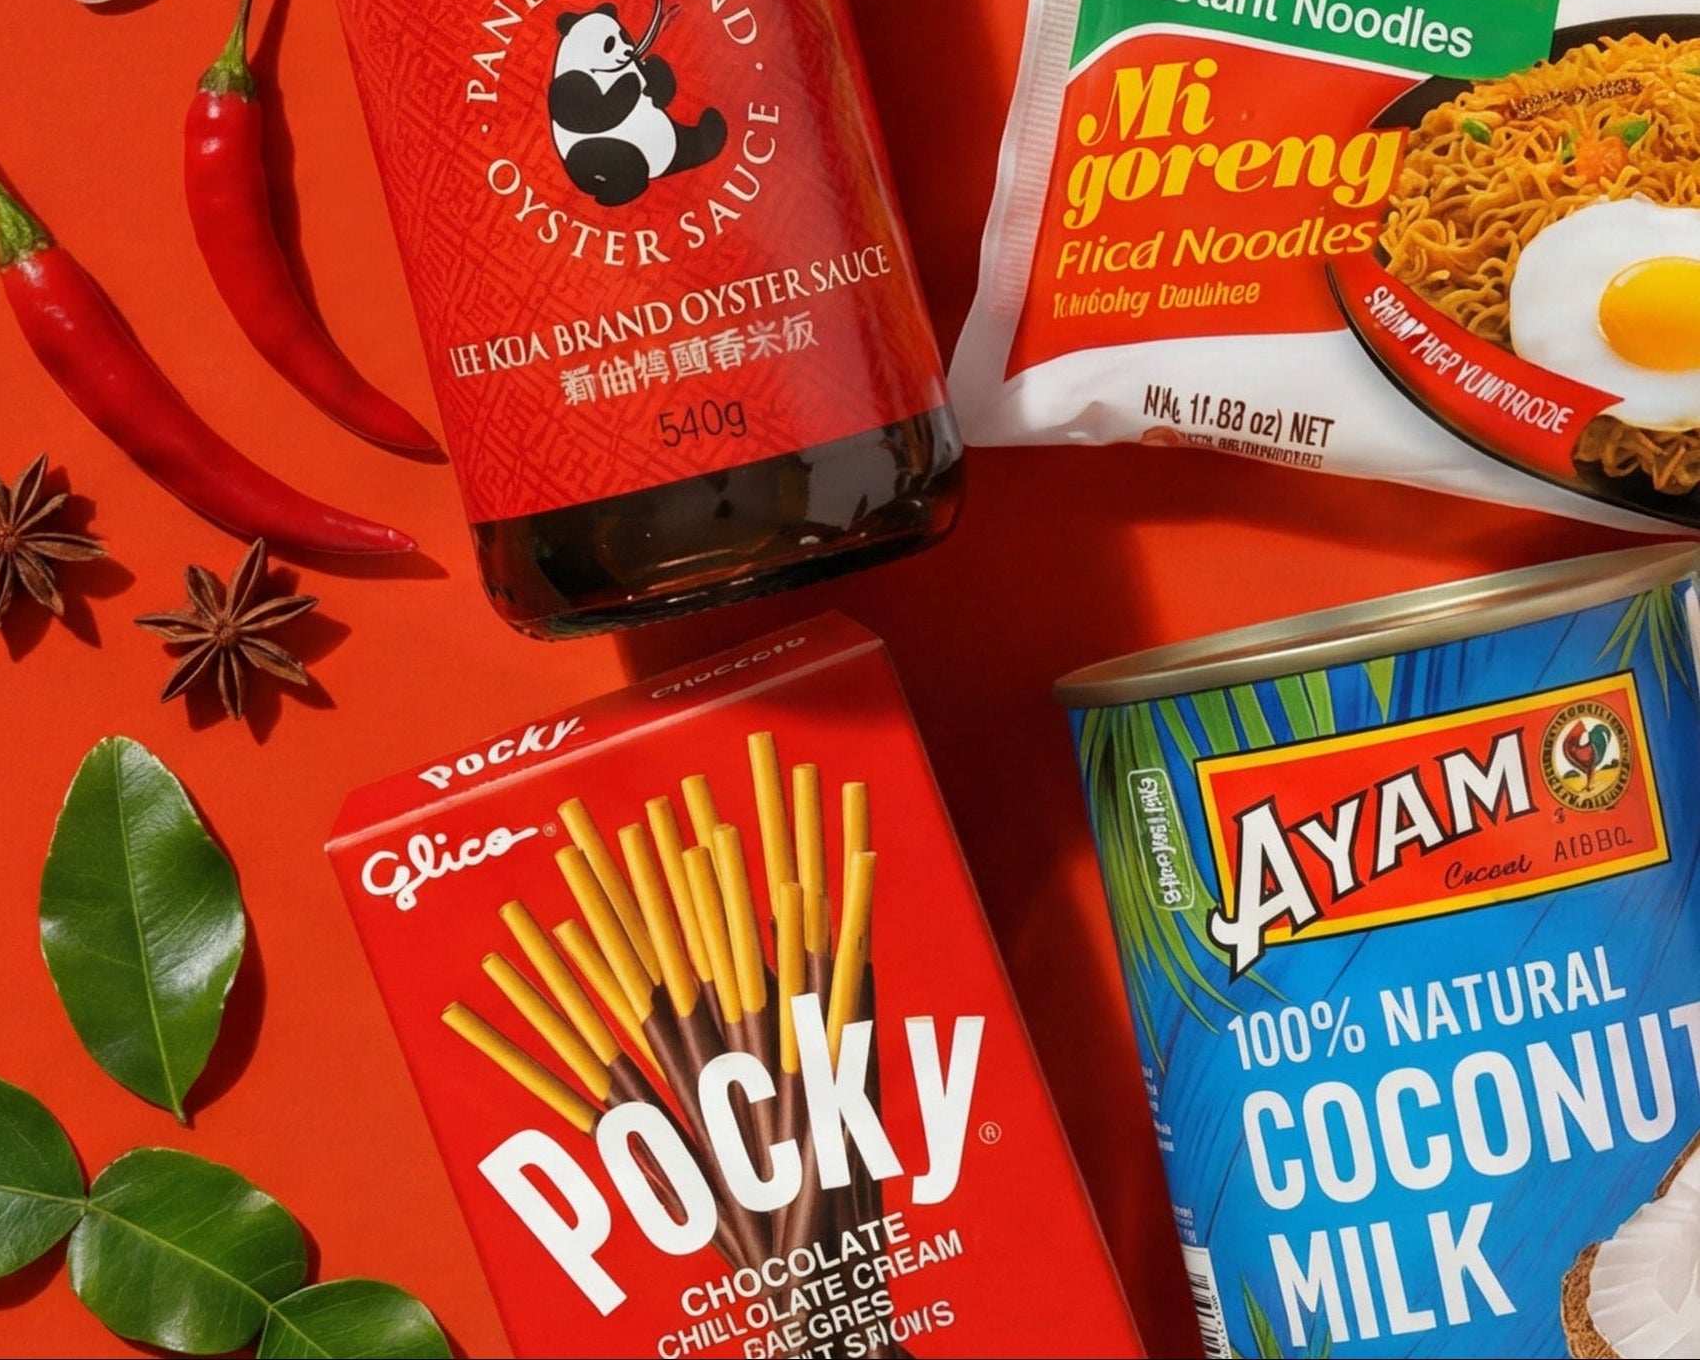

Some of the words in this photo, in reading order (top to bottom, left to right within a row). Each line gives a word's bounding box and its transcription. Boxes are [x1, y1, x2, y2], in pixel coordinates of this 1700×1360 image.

[1077, 57, 1219, 145] Mi
[487, 158, 671, 268] OYSTER
[679, 101, 780, 249] SAUCE
[1062, 126, 1402, 230] goreng
[1171, 216, 1378, 268] Noodles
[551, 299, 674, 358] BRAND
[680, 268, 810, 326] OYSTER
[810, 244, 891, 294] SAUCE
[658, 399, 748, 448] 540g
[1289, 411, 1335, 448] NET
[361, 826, 538, 911] Glico
[1208, 726, 1536, 985] AYAM
[1227, 995, 1366, 1071] 100%
[1379, 945, 1627, 1047] NATURAL
[680, 1211, 911, 1317] CHOCOLATE
[852, 1228, 964, 1290] CREAM
[1267, 1201, 1517, 1348] MILK
